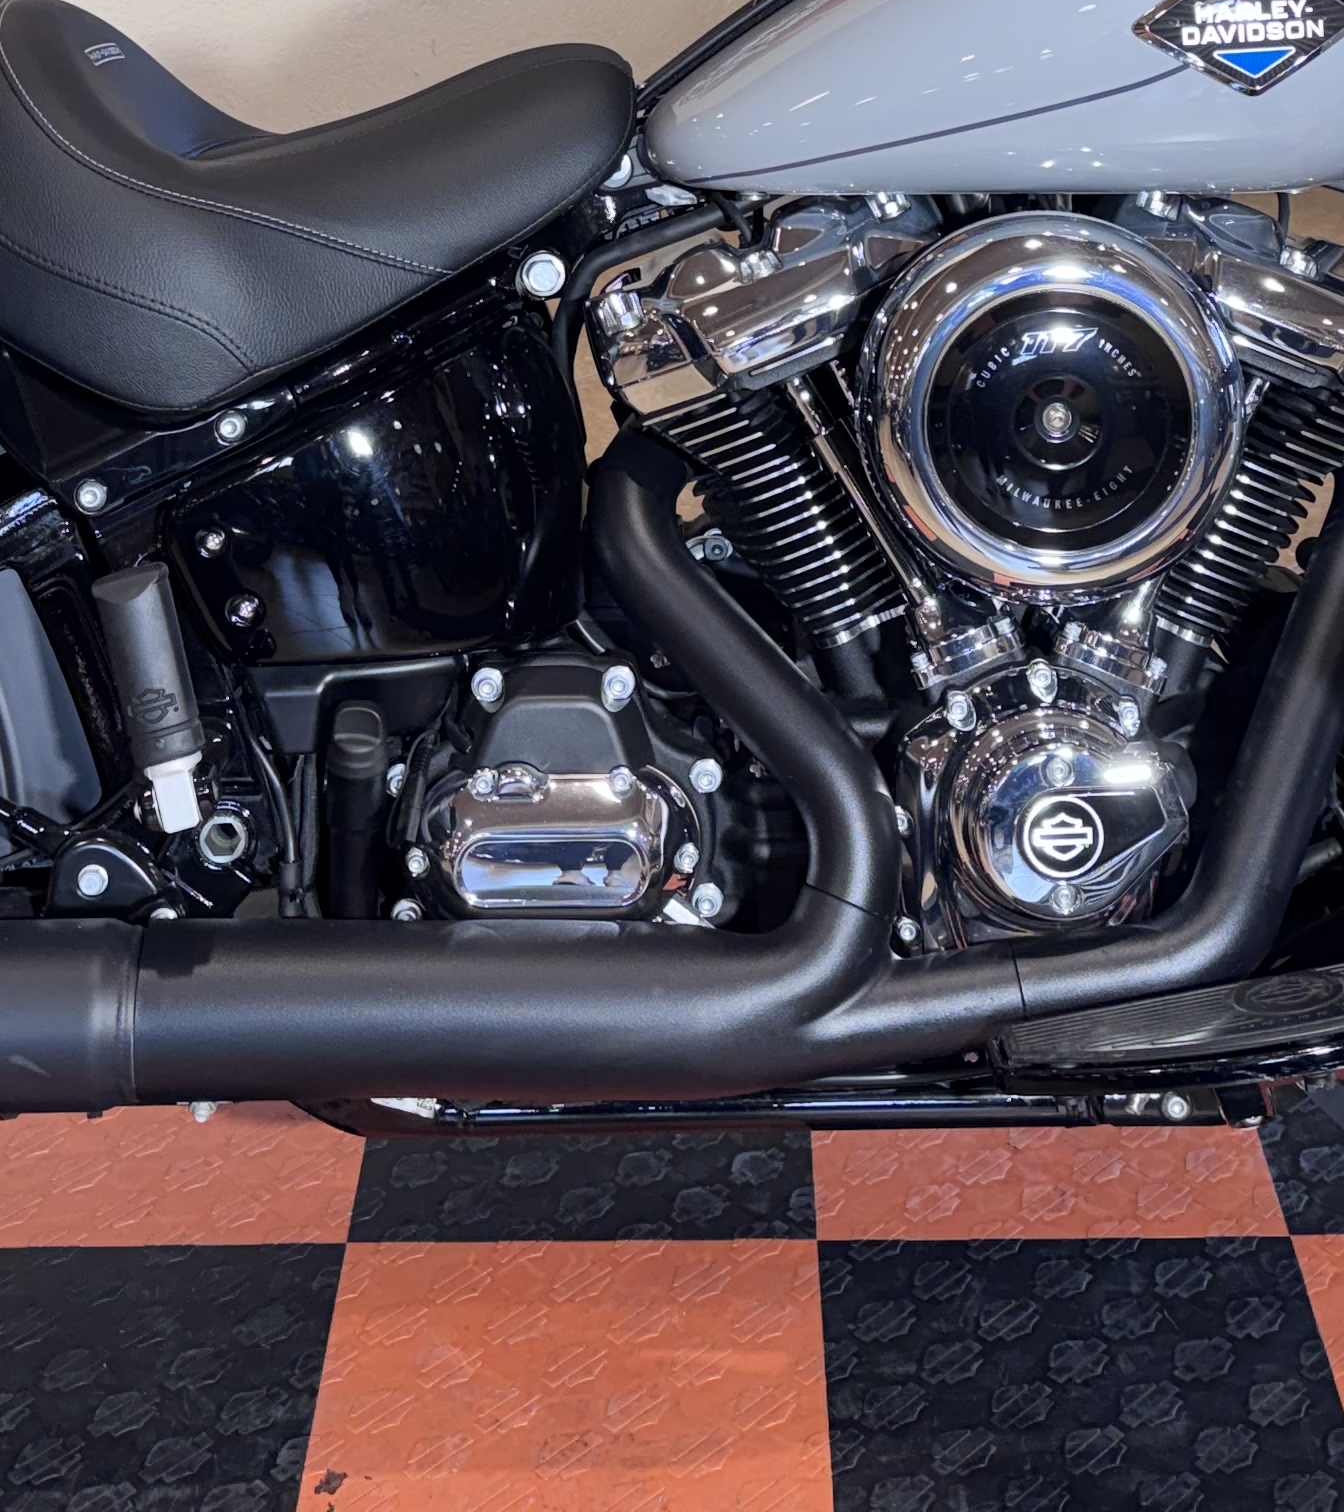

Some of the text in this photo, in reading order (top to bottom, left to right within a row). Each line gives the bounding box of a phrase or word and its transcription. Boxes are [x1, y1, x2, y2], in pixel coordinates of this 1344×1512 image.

[1181, 19, 1325, 46] DAVIDSON
[976, 347, 1011, 389] CUBIC
[1020, 327, 1098, 356] 117
